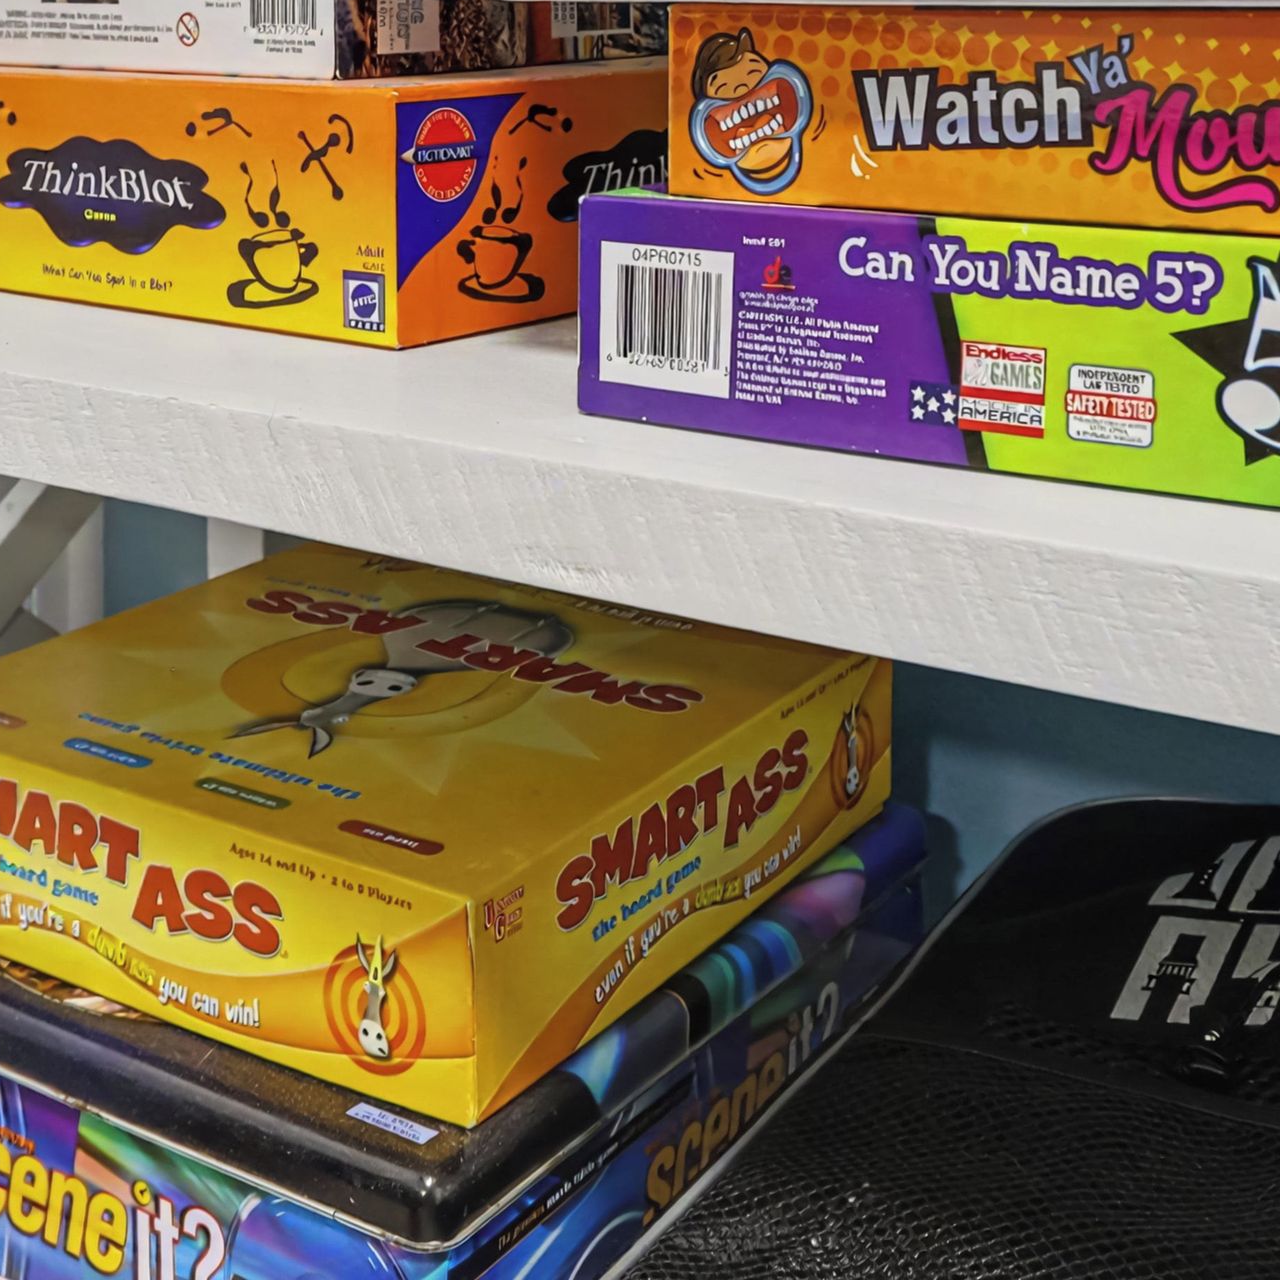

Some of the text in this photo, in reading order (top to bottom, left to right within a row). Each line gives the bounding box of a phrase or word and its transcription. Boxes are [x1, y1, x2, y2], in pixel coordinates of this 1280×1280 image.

[856, 36, 1135, 150] Watch Ya'
[21, 158, 195, 210] ThinkBlot
[838, 236, 1216, 306] Can You Name 5?
[965, 344, 1043, 364] Endless
[990, 361, 1042, 391] GAMES
[960, 406, 1043, 426] AMERICA
[1066, 392, 1155, 420] SAFETY TESTED
[246, 588, 704, 716] SMART ASS
[317, 776, 362, 801] the
[722, 726, 810, 850] ASS
[554, 764, 727, 933] SMART
[51, 877, 99, 908] game
[131, 862, 284, 957] ASS
[591, 855, 702, 944] the board game
[0, 892, 15, 921] if
[17, 896, 64, 936] you're
[71, 920, 81, 939] a
[158, 975, 186, 1007] you
[190, 982, 220, 1019] can
[224, 988, 261, 1030] win!
[594, 958, 624, 1004] even
[624, 935, 636, 965] if
[642, 980, 840, 1215] scene it?
[131, 1179, 227, 1280] it?
